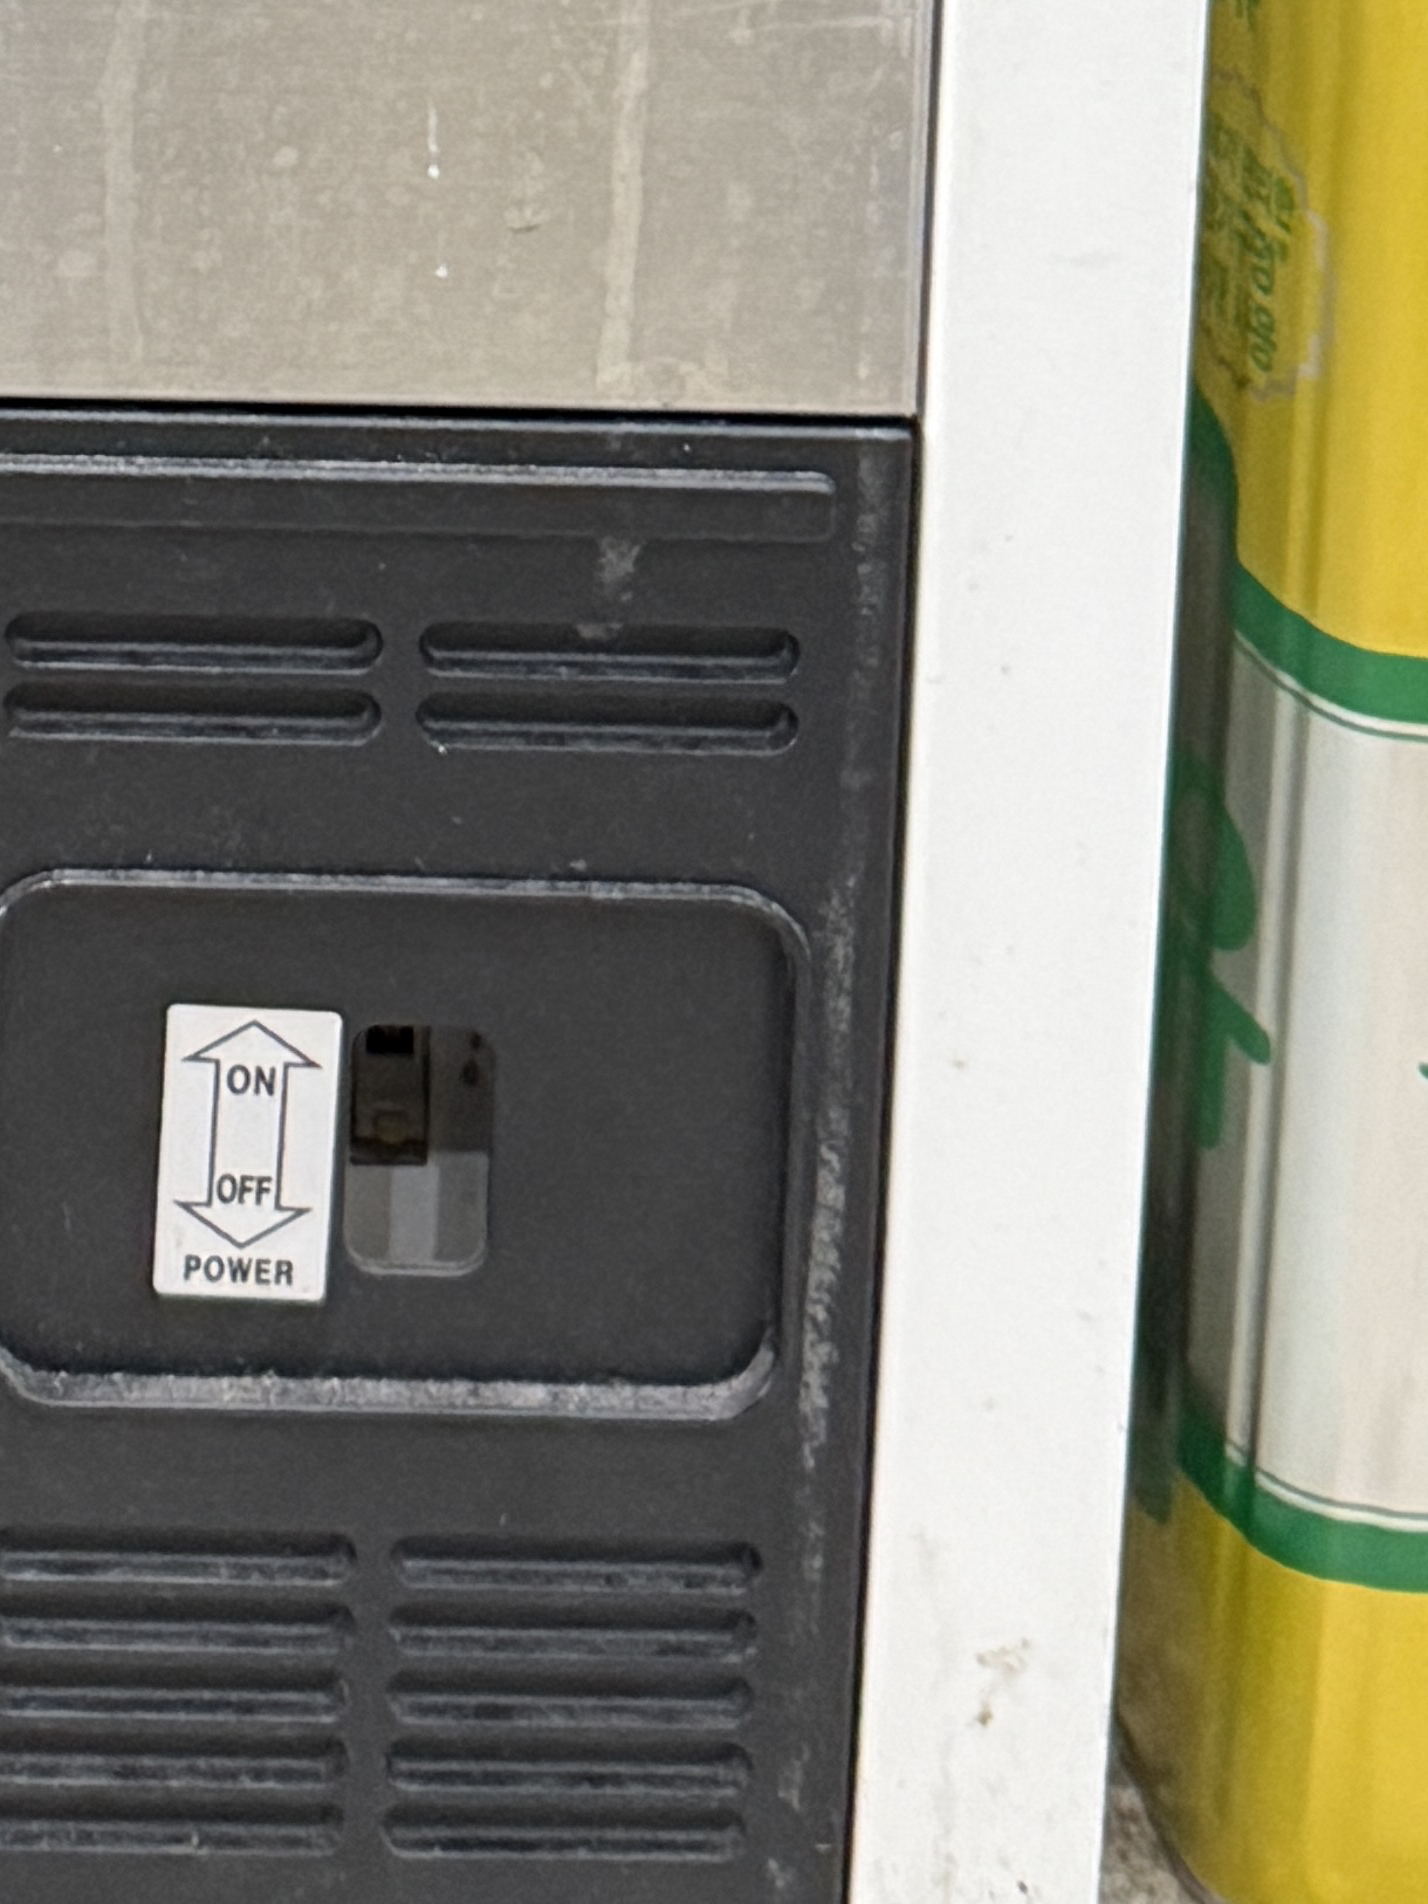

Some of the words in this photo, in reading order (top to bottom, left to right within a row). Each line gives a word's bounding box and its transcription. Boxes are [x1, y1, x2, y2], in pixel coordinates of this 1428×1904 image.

[226, 1064, 276, 1097] ON
[216, 1174, 273, 1206] OFF
[183, 1254, 294, 1286] POWER
